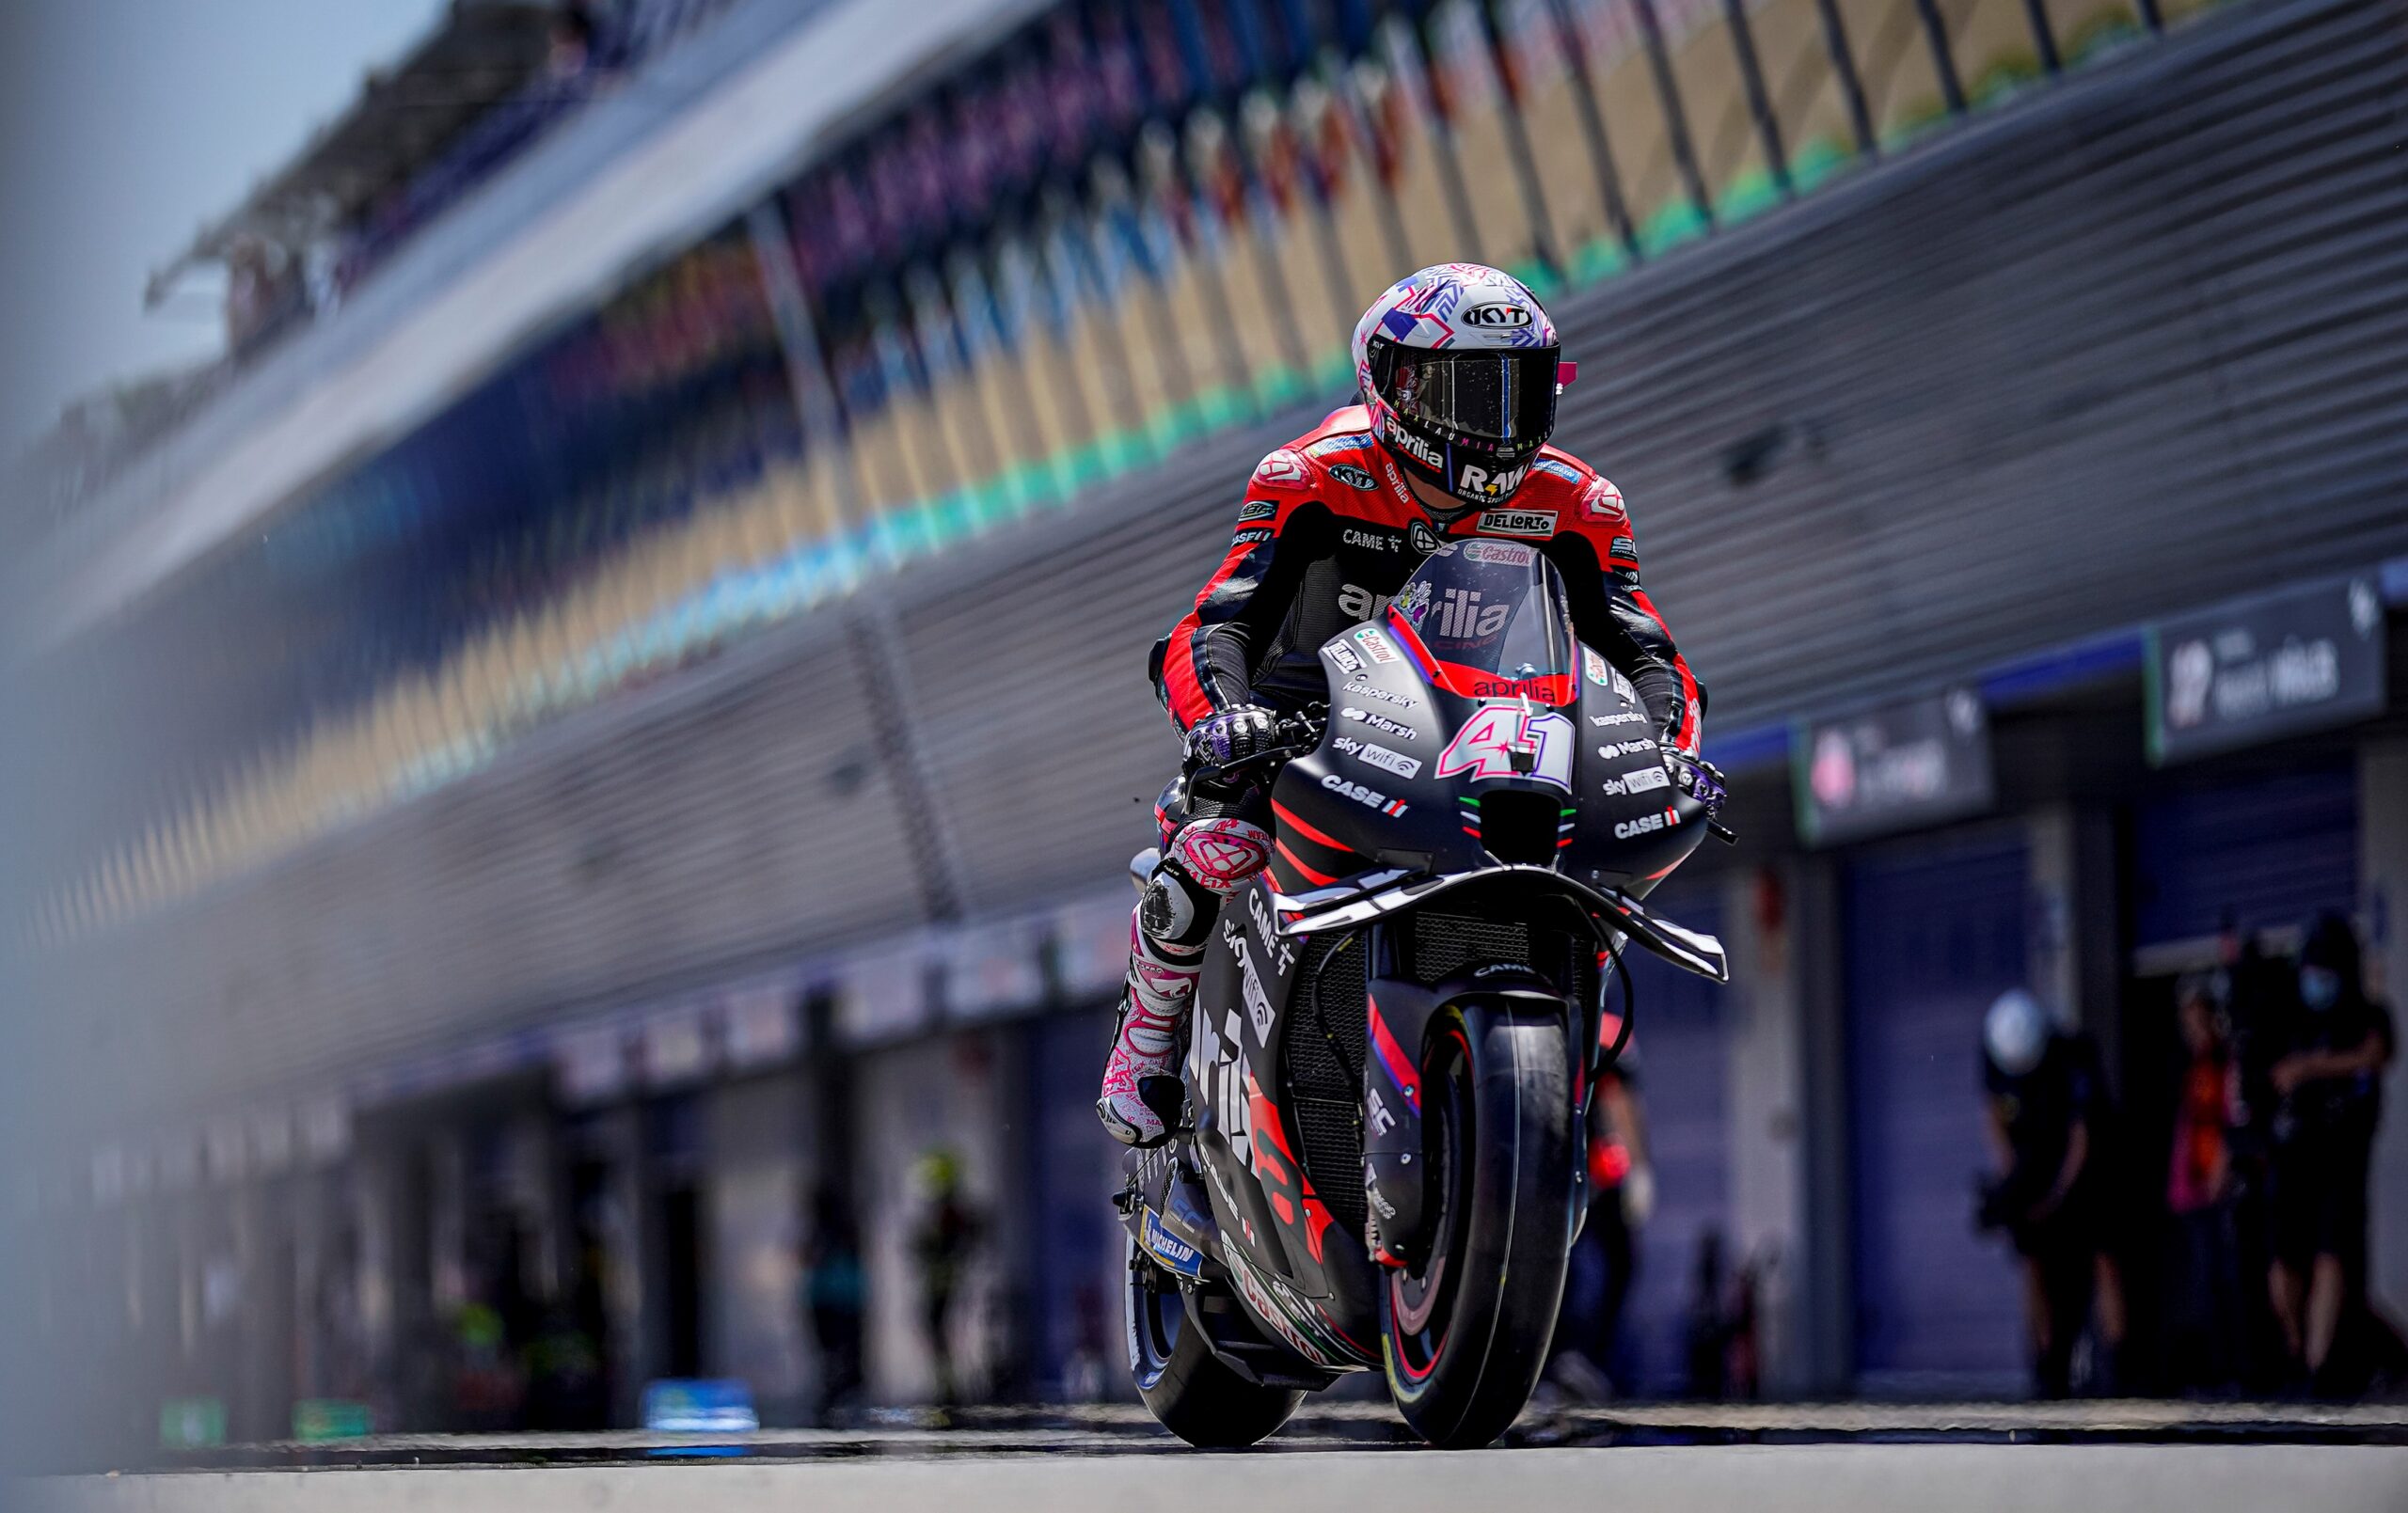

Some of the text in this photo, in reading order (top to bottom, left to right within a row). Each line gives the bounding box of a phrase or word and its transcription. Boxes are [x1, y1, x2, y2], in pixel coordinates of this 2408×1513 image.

[1469, 307, 1528, 326] KYT
[1386, 417, 1444, 469] aprilia
[1385, 462, 1410, 503] aprilia
[1460, 460, 1529, 496] RAW
[1342, 528, 1384, 551] CAME
[1481, 545, 1530, 564] Castrol
[1362, 636, 1396, 662] Castrol
[1342, 681, 1419, 709] kaspersky
[1474, 679, 1557, 704] aprilia
[1365, 714, 1418, 741] Marsh
[1589, 711, 1648, 726] kaspersky
[1332, 736, 1396, 766] sky wifi
[1434, 704, 1576, 796] 41
[1616, 737, 1658, 755] Marsh
[1321, 774, 1386, 809] CASE
[1602, 779, 1627, 796] sky
[1614, 812, 1664, 840] CASE
[1248, 887, 1279, 959] CAME
[1150, 1228, 1195, 1263] MICHELIN
[1243, 1269, 1325, 1365] Castrol
